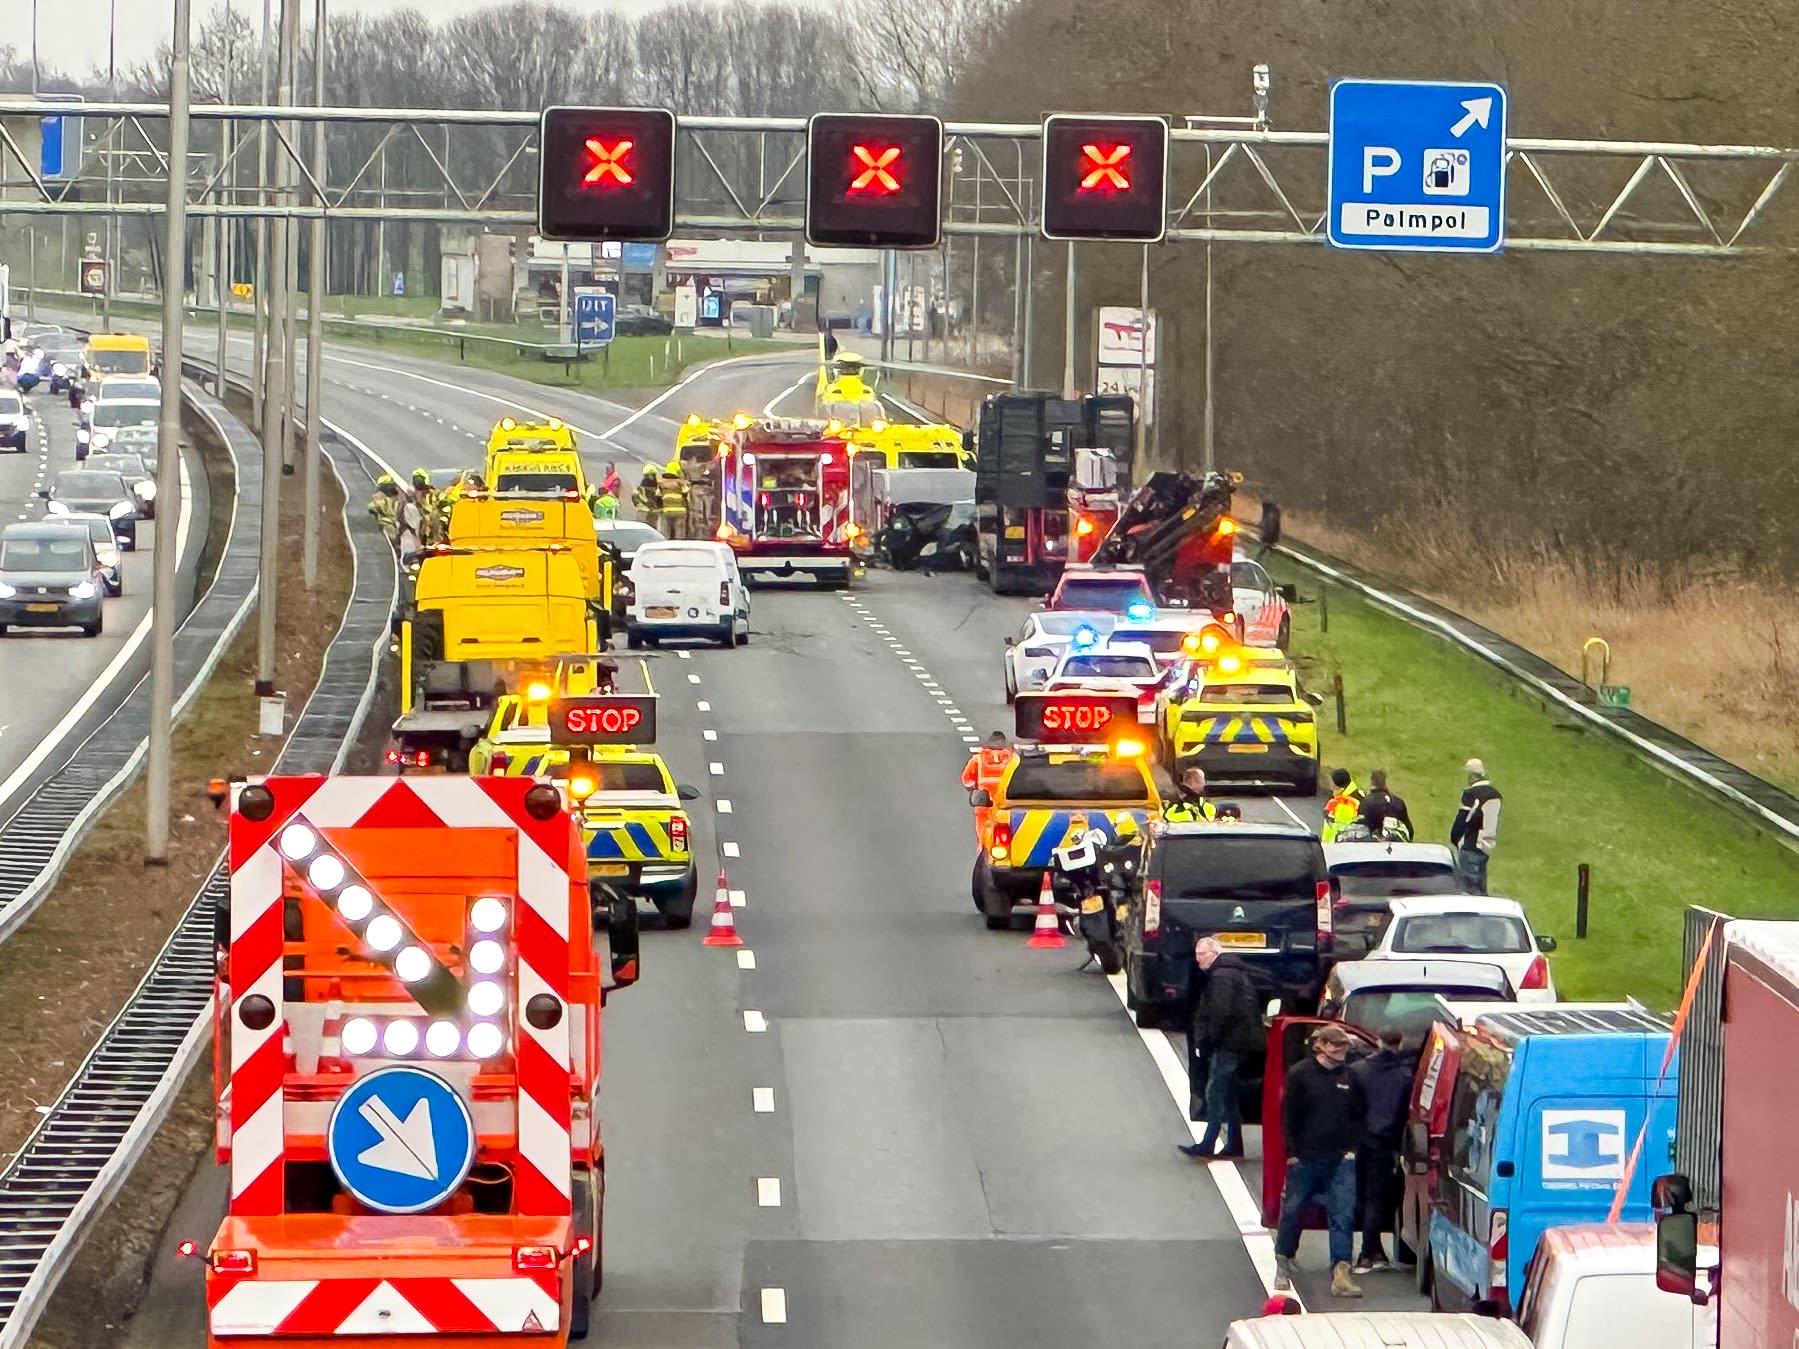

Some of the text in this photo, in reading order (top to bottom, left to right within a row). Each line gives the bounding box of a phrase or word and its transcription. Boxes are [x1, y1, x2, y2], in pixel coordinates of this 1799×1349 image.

[1362, 146, 1402, 194] P
[1366, 208, 1466, 232] Palmpol
[567, 708, 640, 732] STOP
[1043, 705, 1111, 729] STOP
